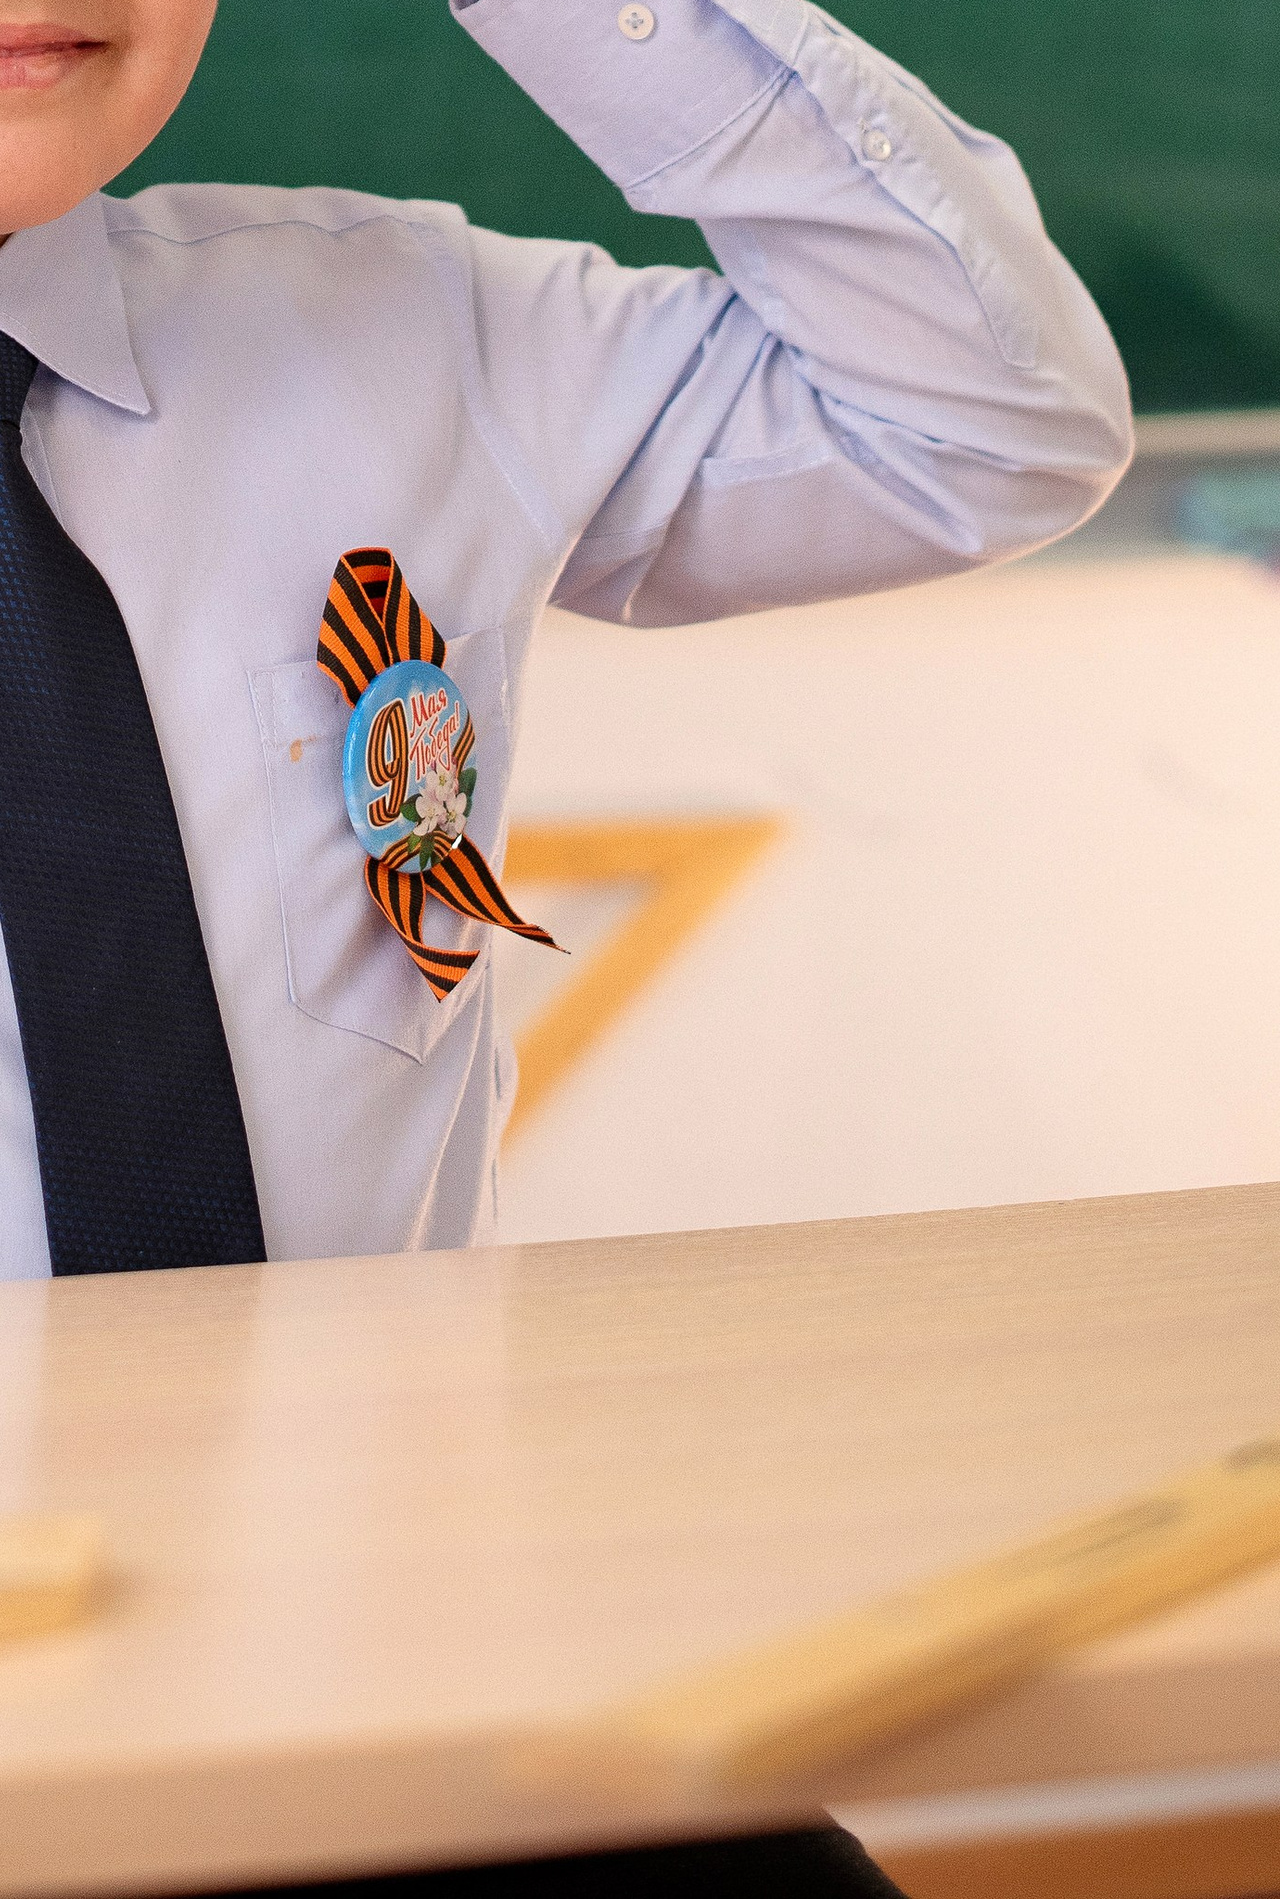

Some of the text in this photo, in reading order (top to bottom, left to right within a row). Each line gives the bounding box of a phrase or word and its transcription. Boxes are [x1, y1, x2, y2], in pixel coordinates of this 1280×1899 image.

[367, 689, 447, 828] 9 Мая
[409, 702, 460, 781] Победа!
